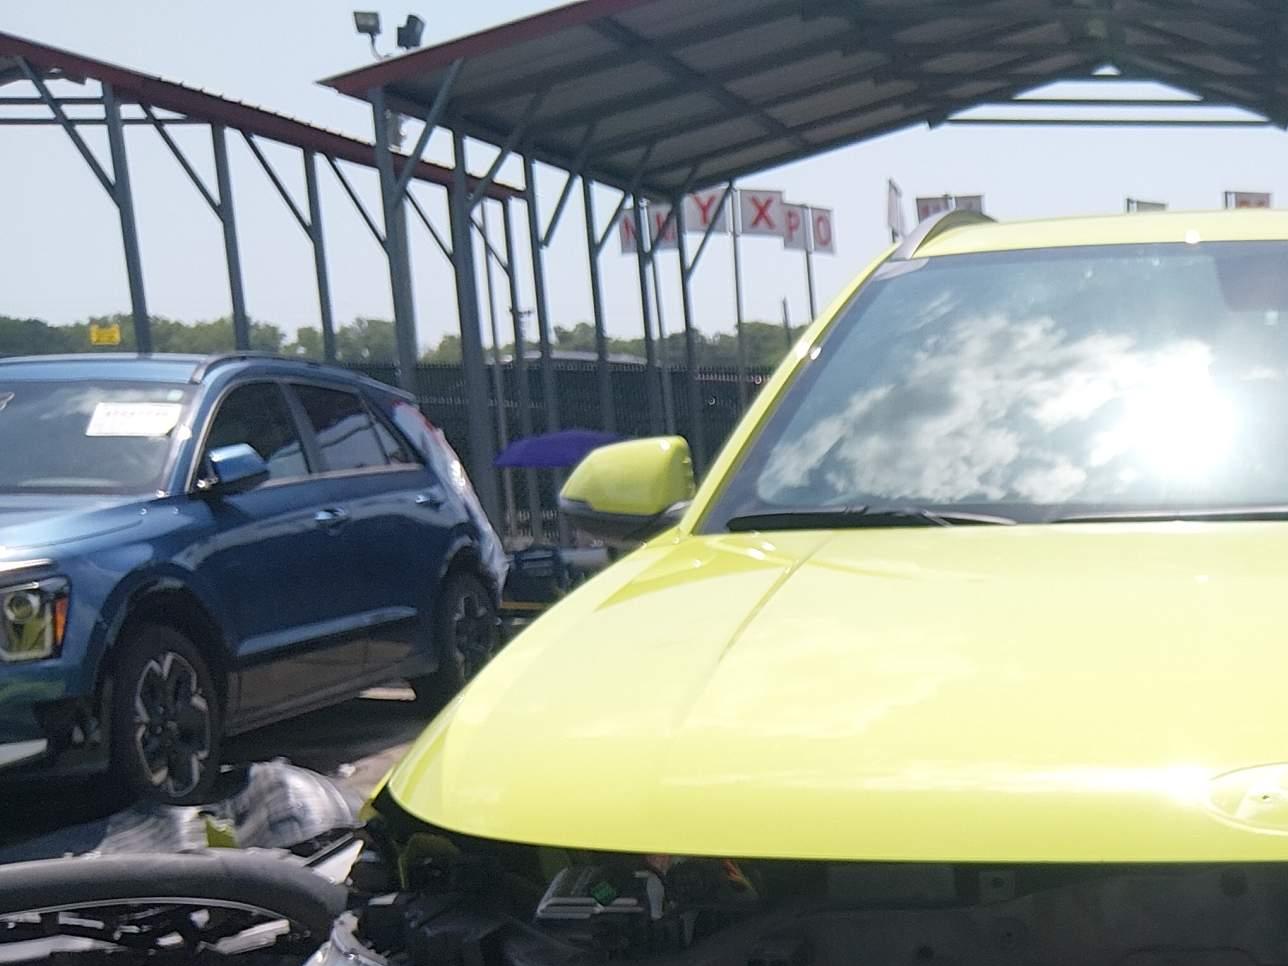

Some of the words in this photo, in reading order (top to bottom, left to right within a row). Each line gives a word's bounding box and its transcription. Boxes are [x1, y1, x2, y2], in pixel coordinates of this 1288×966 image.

[693, 194, 716, 224] Y
[751, 196, 775, 230] X
[786, 209, 800, 242] P
